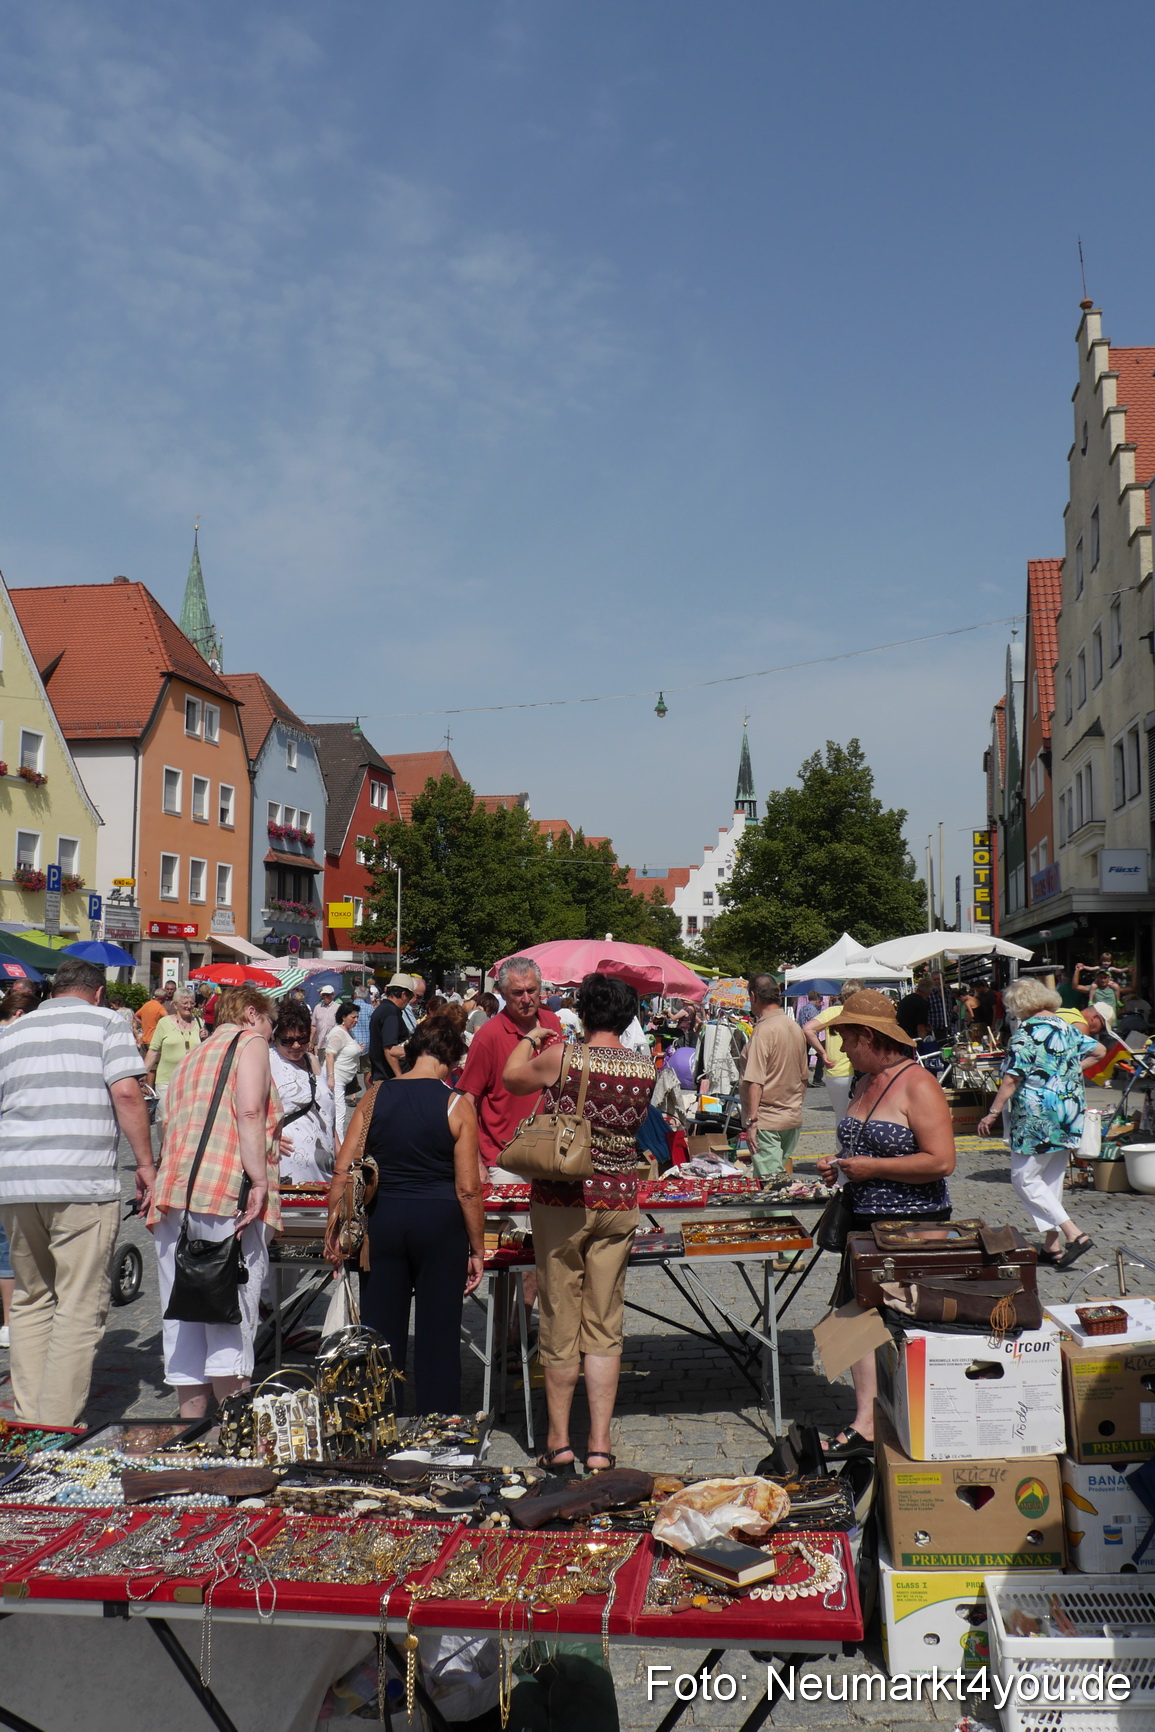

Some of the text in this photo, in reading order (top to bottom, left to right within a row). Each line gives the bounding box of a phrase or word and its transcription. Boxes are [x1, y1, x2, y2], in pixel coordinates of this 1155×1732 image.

[50, 868, 58, 888] P
[974, 832, 990, 921] HOTEL
[91, 898, 100, 917] P
[1005, 1340, 1050, 1357] circon
[912, 1554, 1052, 1566] PREMIUM BANANAS
